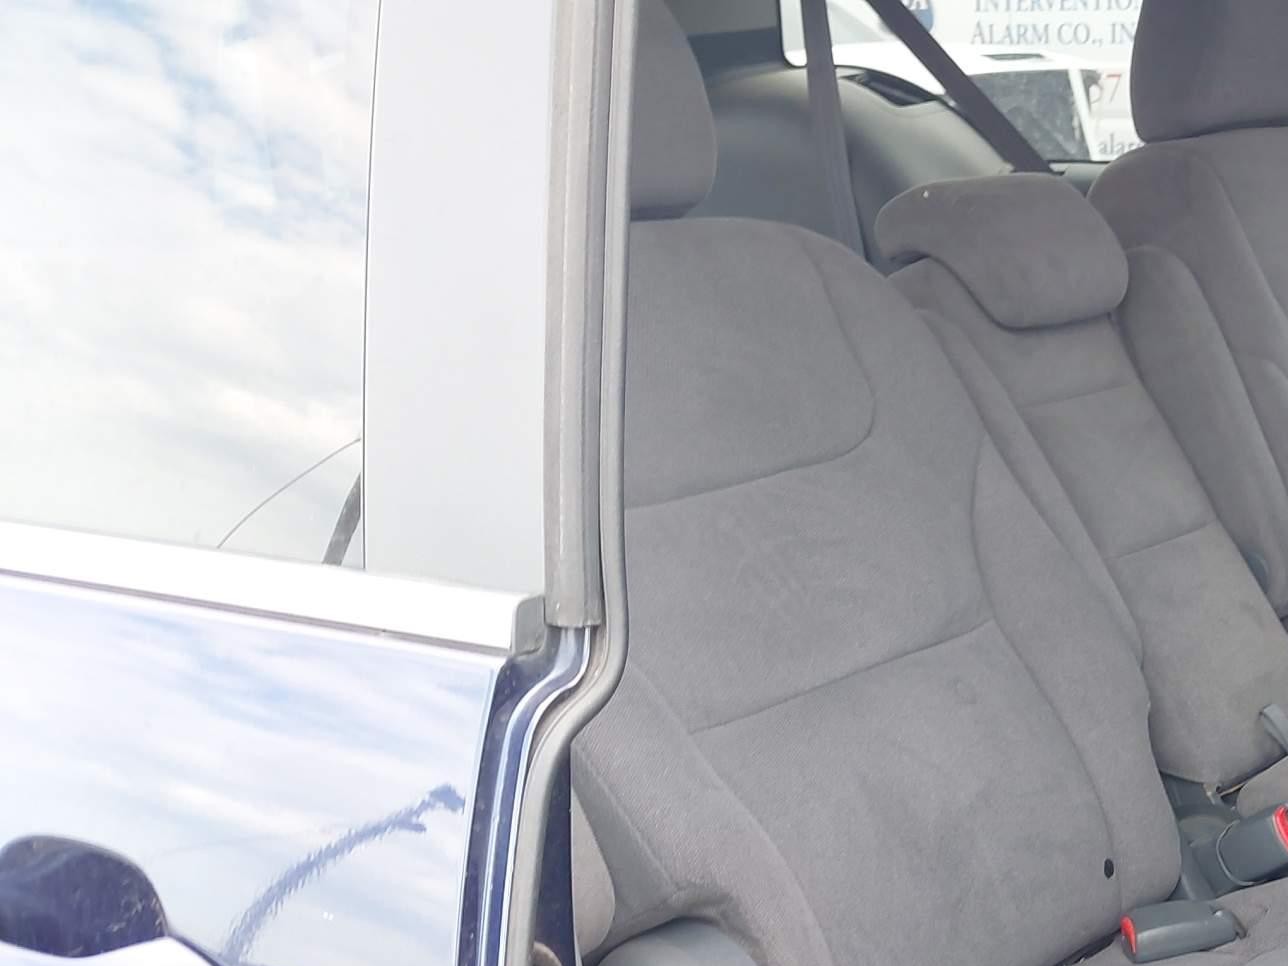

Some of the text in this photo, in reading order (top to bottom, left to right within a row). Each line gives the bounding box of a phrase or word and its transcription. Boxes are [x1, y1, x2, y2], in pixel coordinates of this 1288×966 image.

[974, 0, 1139, 12] INTERVENTIO
[970, 20, 1138, 47] ALARM CO., IN
